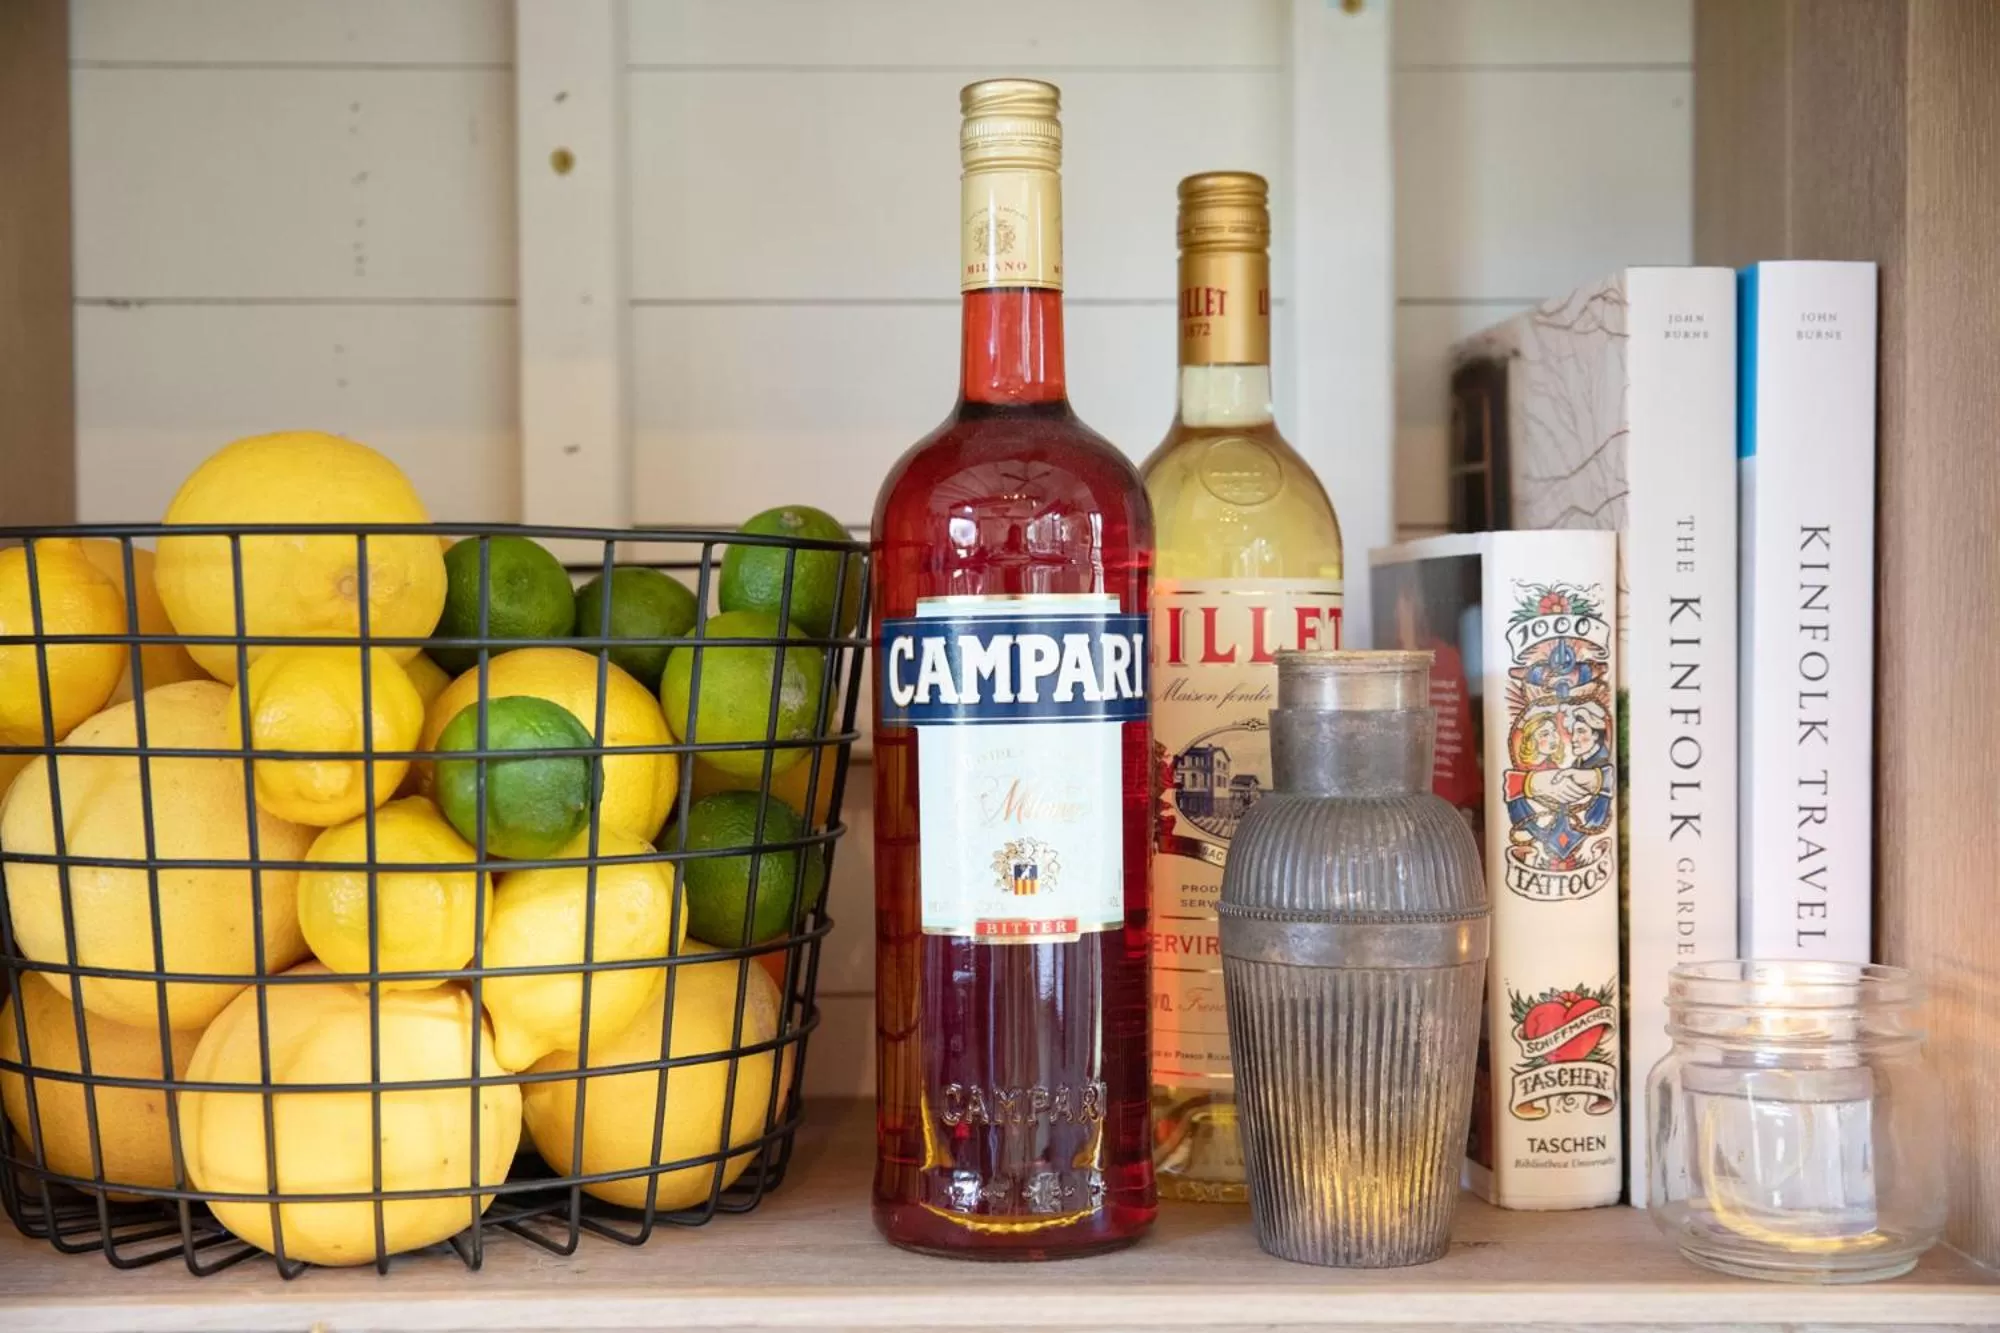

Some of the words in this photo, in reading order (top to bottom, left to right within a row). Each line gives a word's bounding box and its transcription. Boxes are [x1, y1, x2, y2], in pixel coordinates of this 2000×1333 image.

[1668, 314, 1704, 324] JOHN
[1796, 330, 1842, 341] BURNE
[1801, 312, 1838, 323] JOHN
[1676, 515, 1695, 573] THE
[1151, 607, 1343, 664] ILLET
[1799, 525, 1831, 745] KINFOLK
[888, 632, 1144, 708] CAMPARI
[1669, 596, 1702, 842] KINFOLK
[1797, 769, 1828, 948] TRAVEL
[1181, 884, 1219, 893] PROD
[1513, 863, 1607, 897] TATTOOS
[986, 921, 1068, 935] BITTER
[1676, 856, 1696, 964] GARDE
[1526, 1009, 1613, 1055] SCHIFFMACHER
[1519, 1067, 1610, 1097] TASCHEN
[1527, 1135, 1606, 1154] TASCHEN
